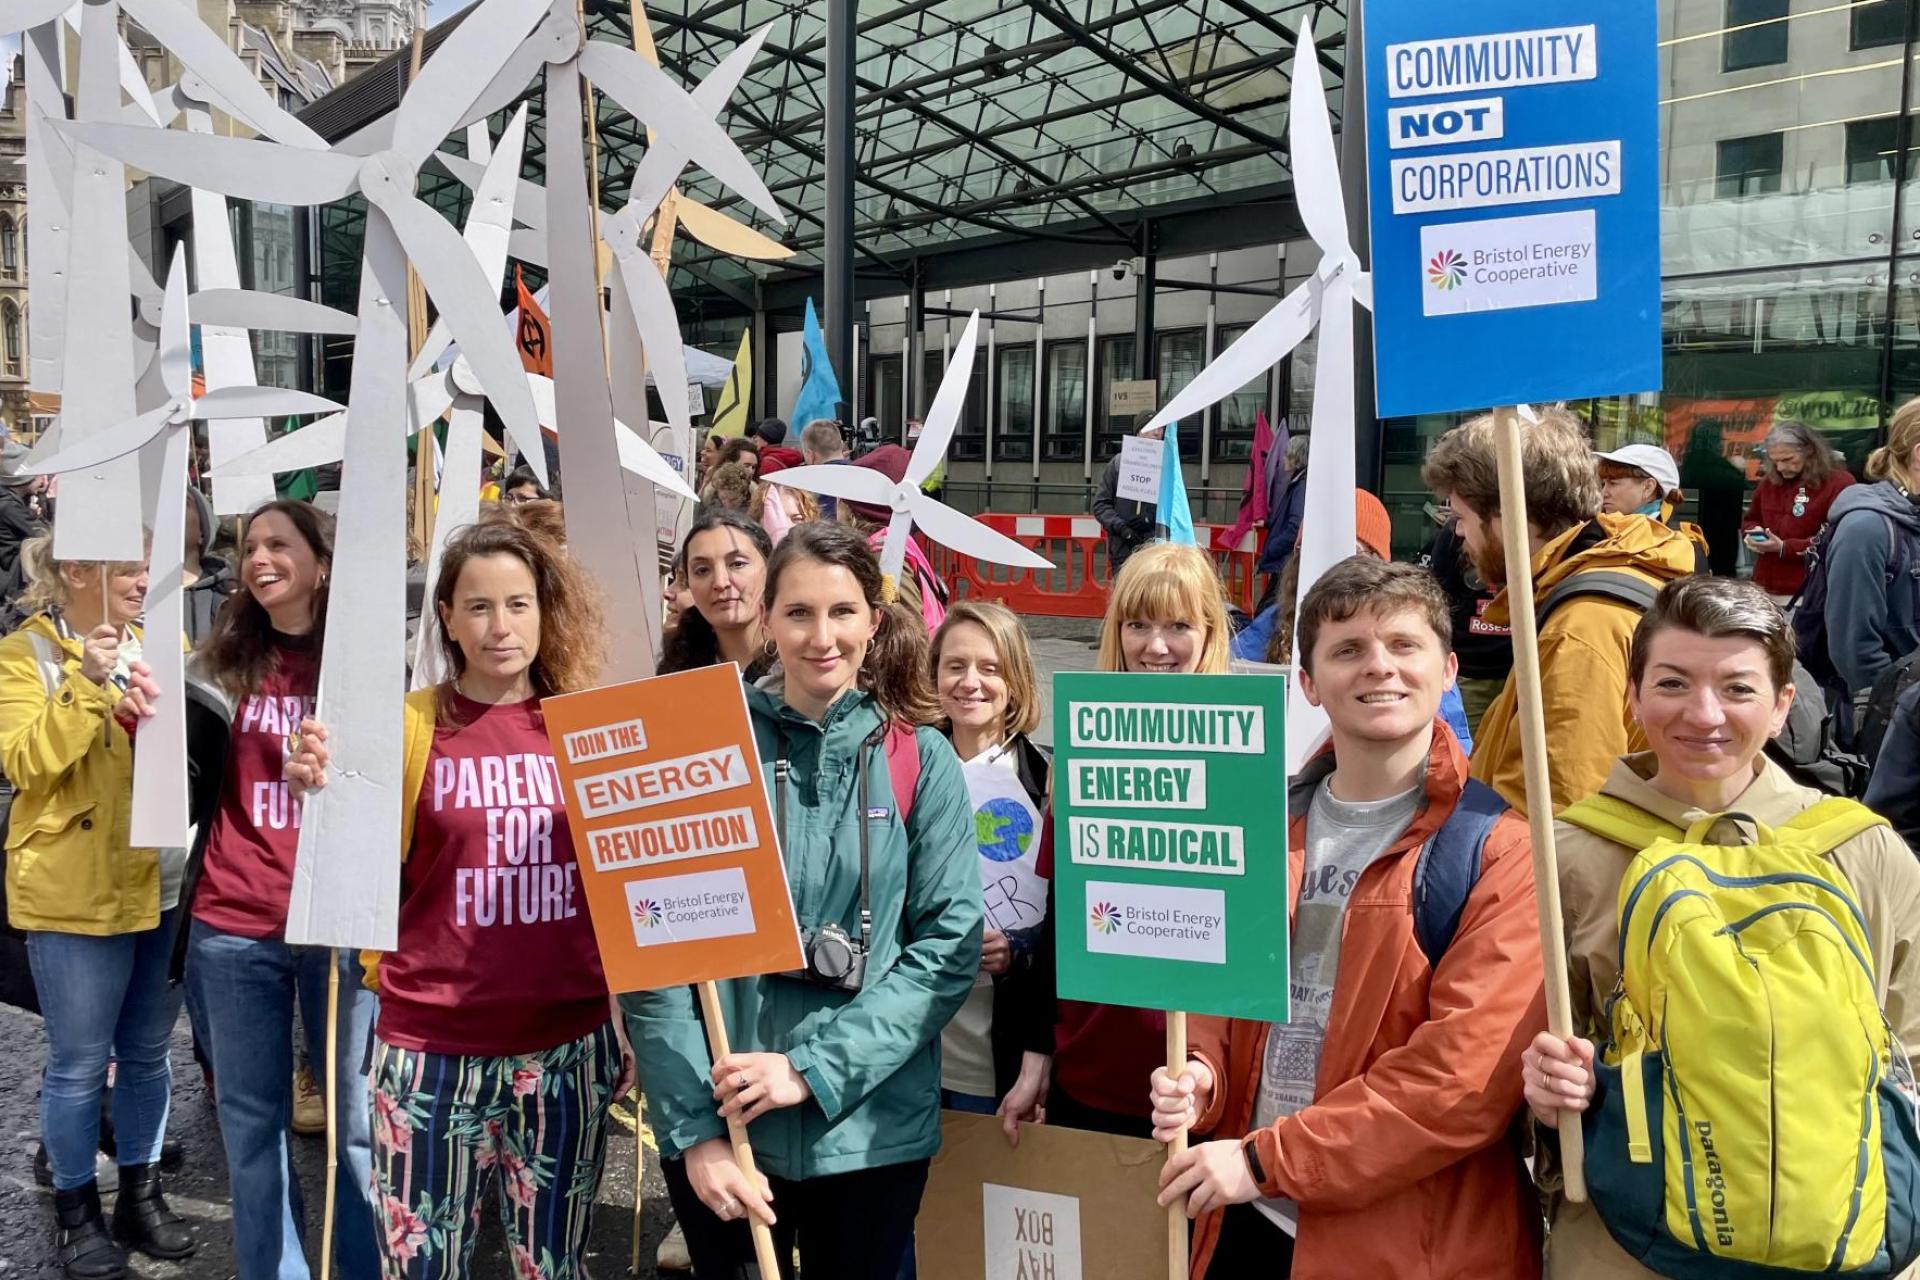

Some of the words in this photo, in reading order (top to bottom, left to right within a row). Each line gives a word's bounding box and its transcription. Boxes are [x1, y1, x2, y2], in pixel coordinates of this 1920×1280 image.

[1395, 32, 1583, 90] COMMUNITY
[1400, 107, 1490, 139] NOT
[1401, 151, 1611, 202] CORPORATIONS
[1473, 245, 1528, 266] Bristol
[1532, 240, 1592, 262] Energy
[1474, 261, 1578, 284] Cooperative
[1130, 474, 1152, 484] STOP
[570, 731, 608, 759] JOIN
[608, 725, 642, 749] THE
[1077, 706, 1255, 746] COMMUNITY
[584, 754, 734, 809] ENERGY
[1079, 766, 1191, 802] ENERGY
[486, 807, 553, 866] FOR
[594, 814, 748, 864] REVOLUTION
[1079, 823, 1100, 858] IS
[1106, 825, 1238, 867] RADICAL
[456, 862, 577, 927] FUTURE
[663, 897, 702, 911] Bristol
[703, 890, 745, 906] Energy
[667, 904, 739, 924] Cooperative
[1126, 906, 1170, 923] Bristol
[1173, 910, 1221, 930] Energy
[1127, 922, 1210, 941] Cooperative
[1695, 1120, 1735, 1246] patagonia
[1015, 1207, 1053, 1247] BOX
